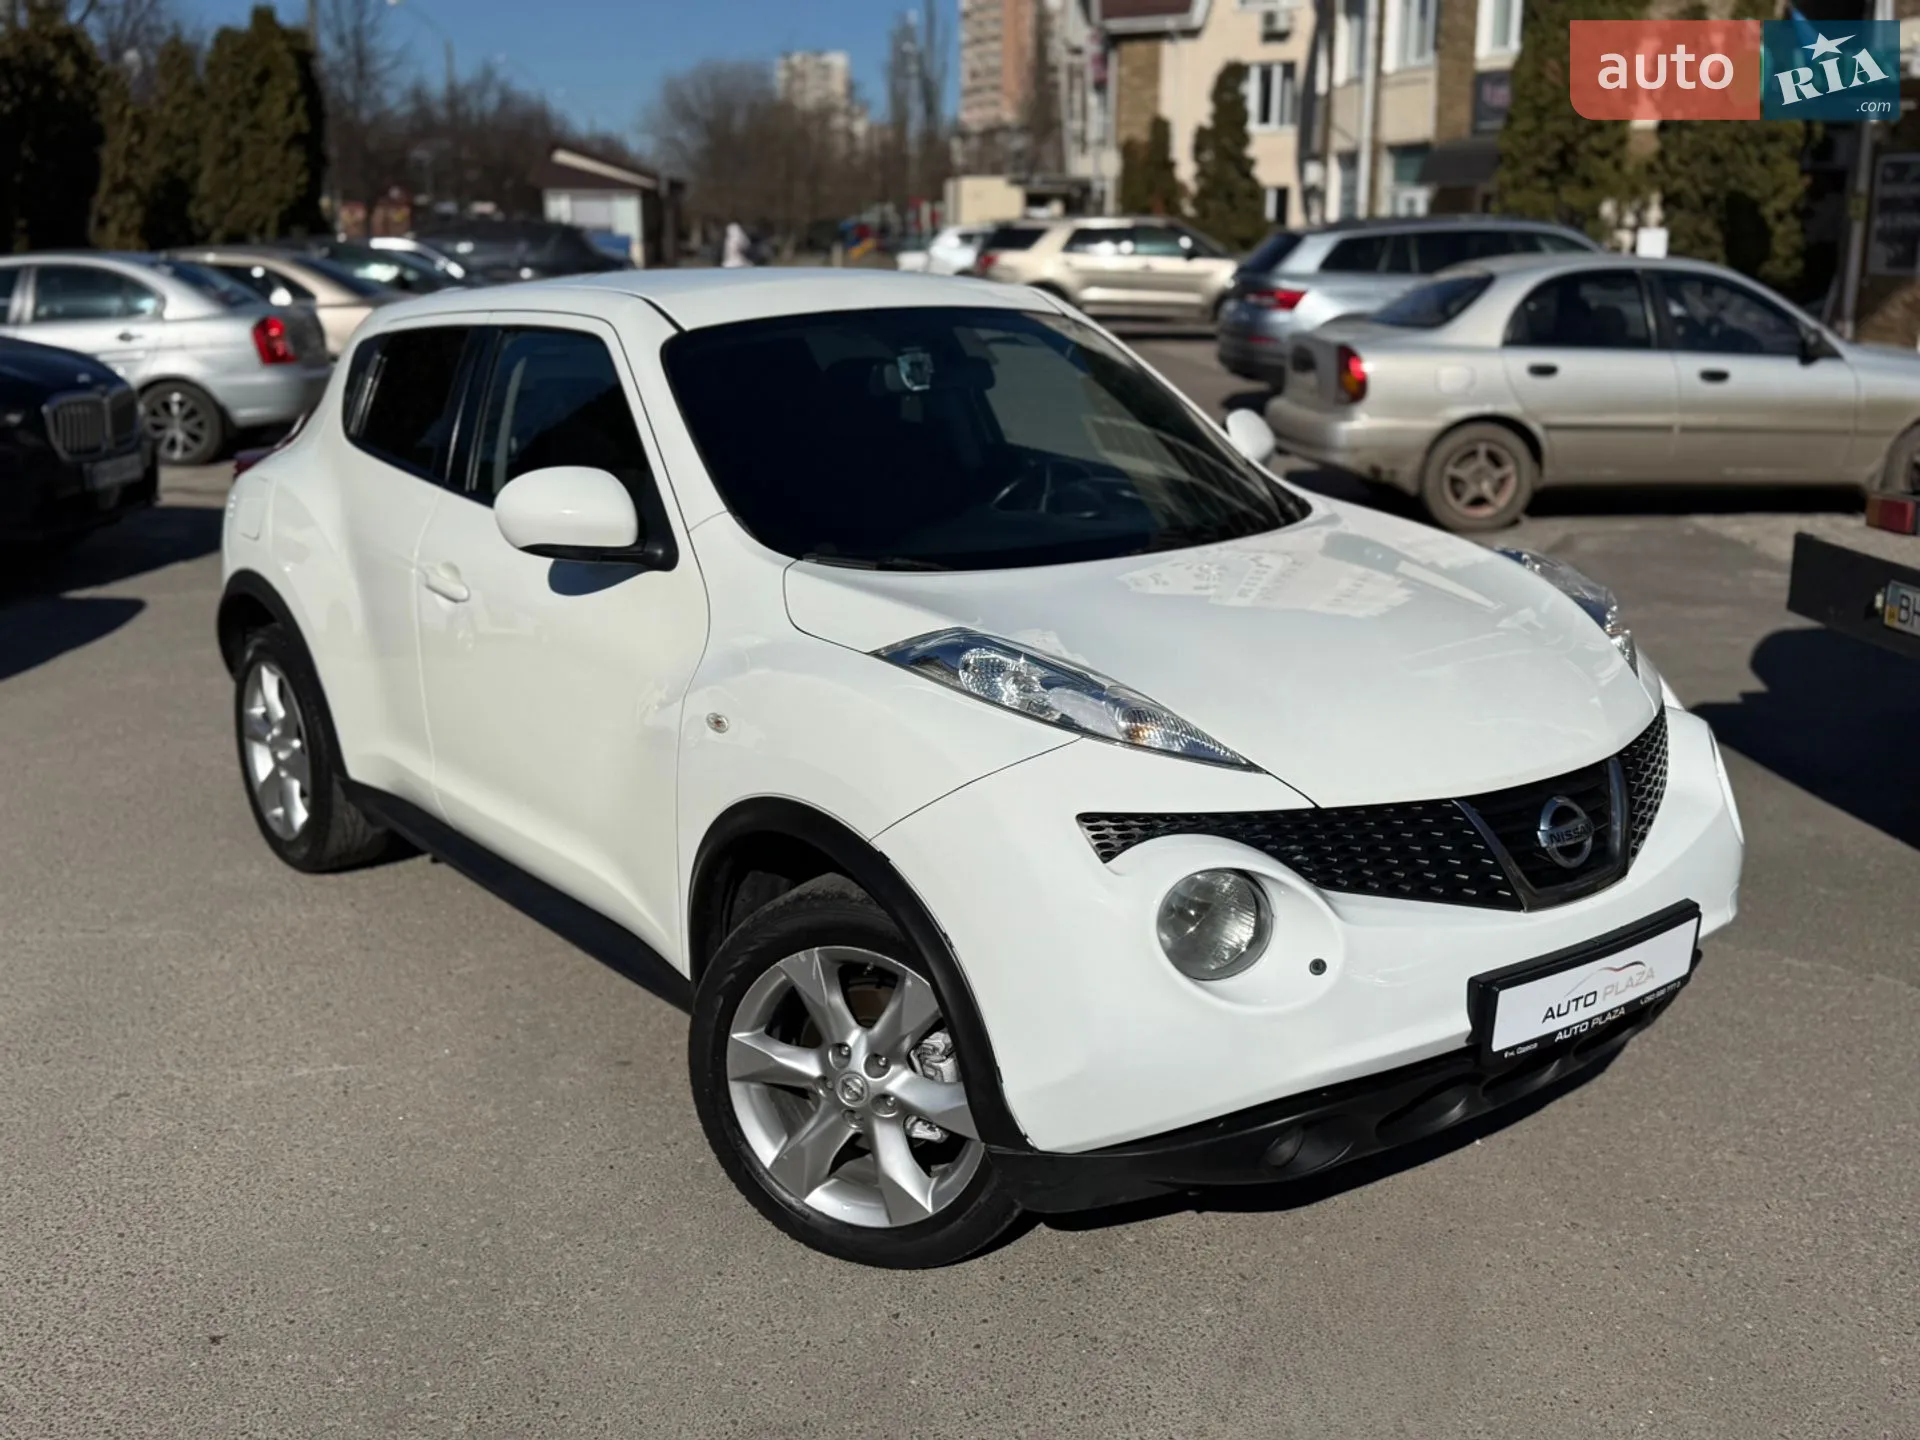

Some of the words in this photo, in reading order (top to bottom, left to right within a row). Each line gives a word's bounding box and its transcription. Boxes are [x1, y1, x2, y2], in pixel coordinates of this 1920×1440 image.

[1541, 990, 1598, 1024] AUTO
[1602, 967, 1656, 1002] PLAZA
[1554, 1020, 1590, 1043] AUTO
[1590, 1006, 1626, 1029] PLAZA
